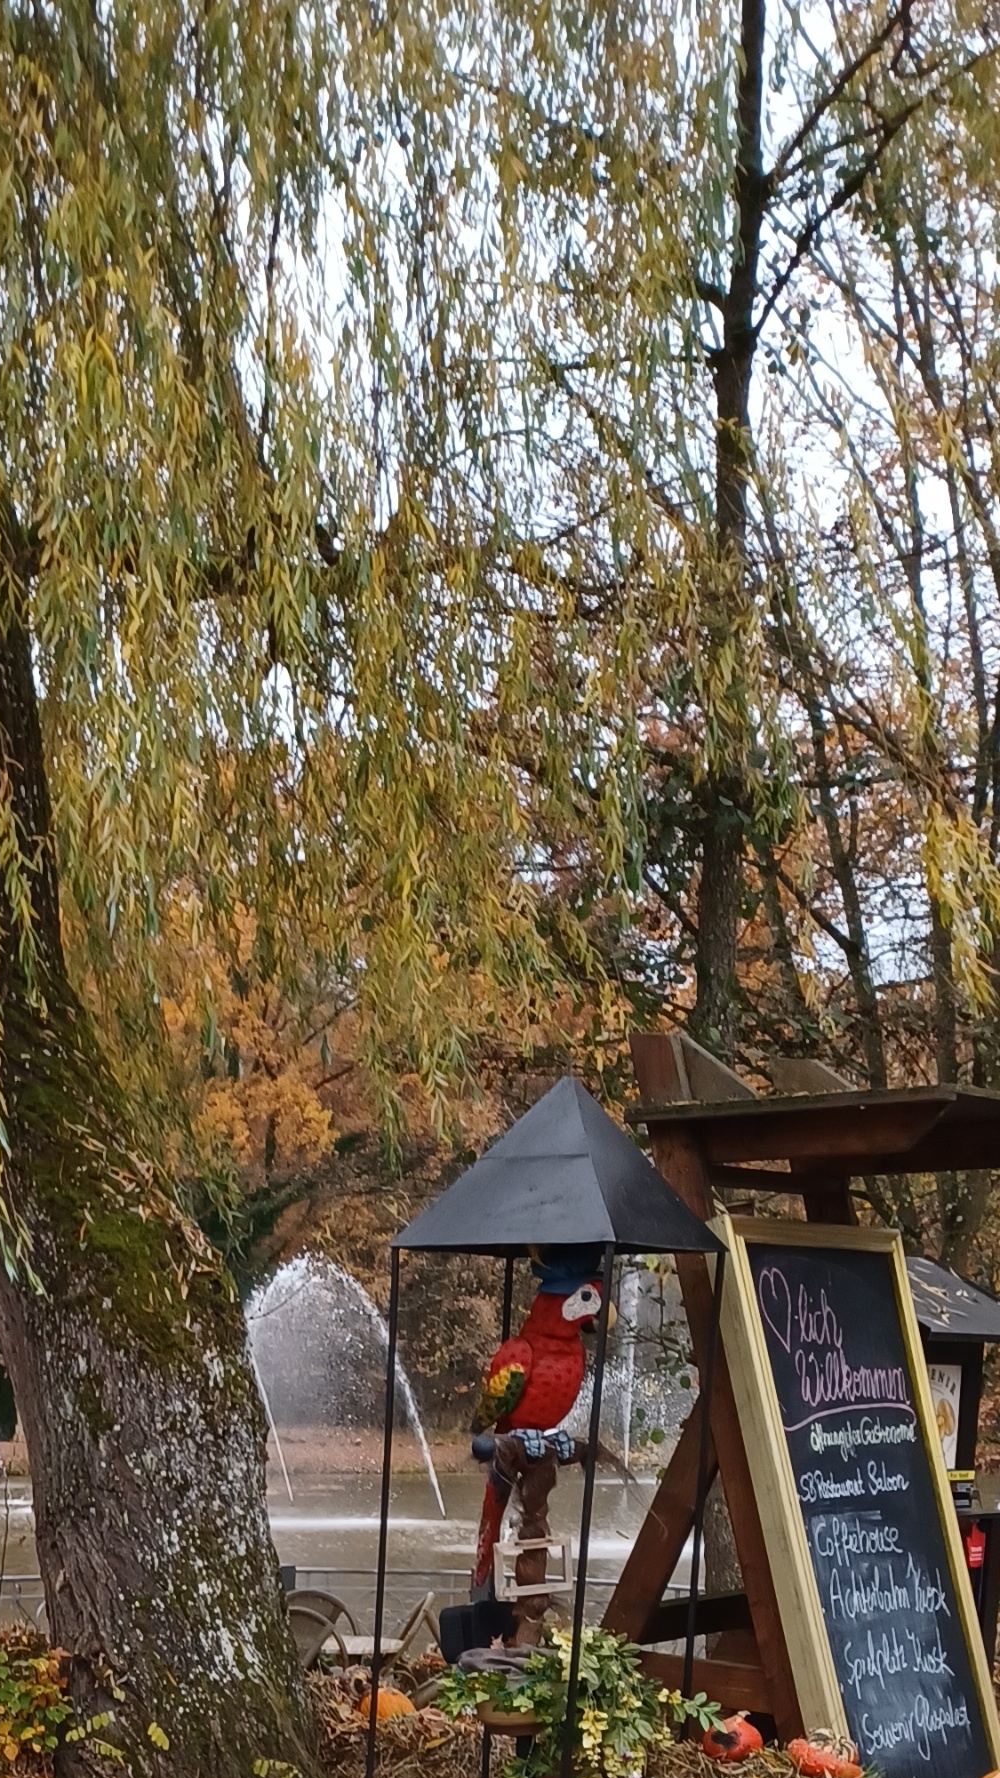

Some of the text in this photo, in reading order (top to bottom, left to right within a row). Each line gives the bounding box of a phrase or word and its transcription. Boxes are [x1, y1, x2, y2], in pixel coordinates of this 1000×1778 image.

[795, 1349, 910, 1407] Willkommen
[867, 1460, 909, 1496] Saloon
[829, 1551, 951, 1620] Achterbahn Kiosk
[905, 1626, 955, 1677] Kiosk
